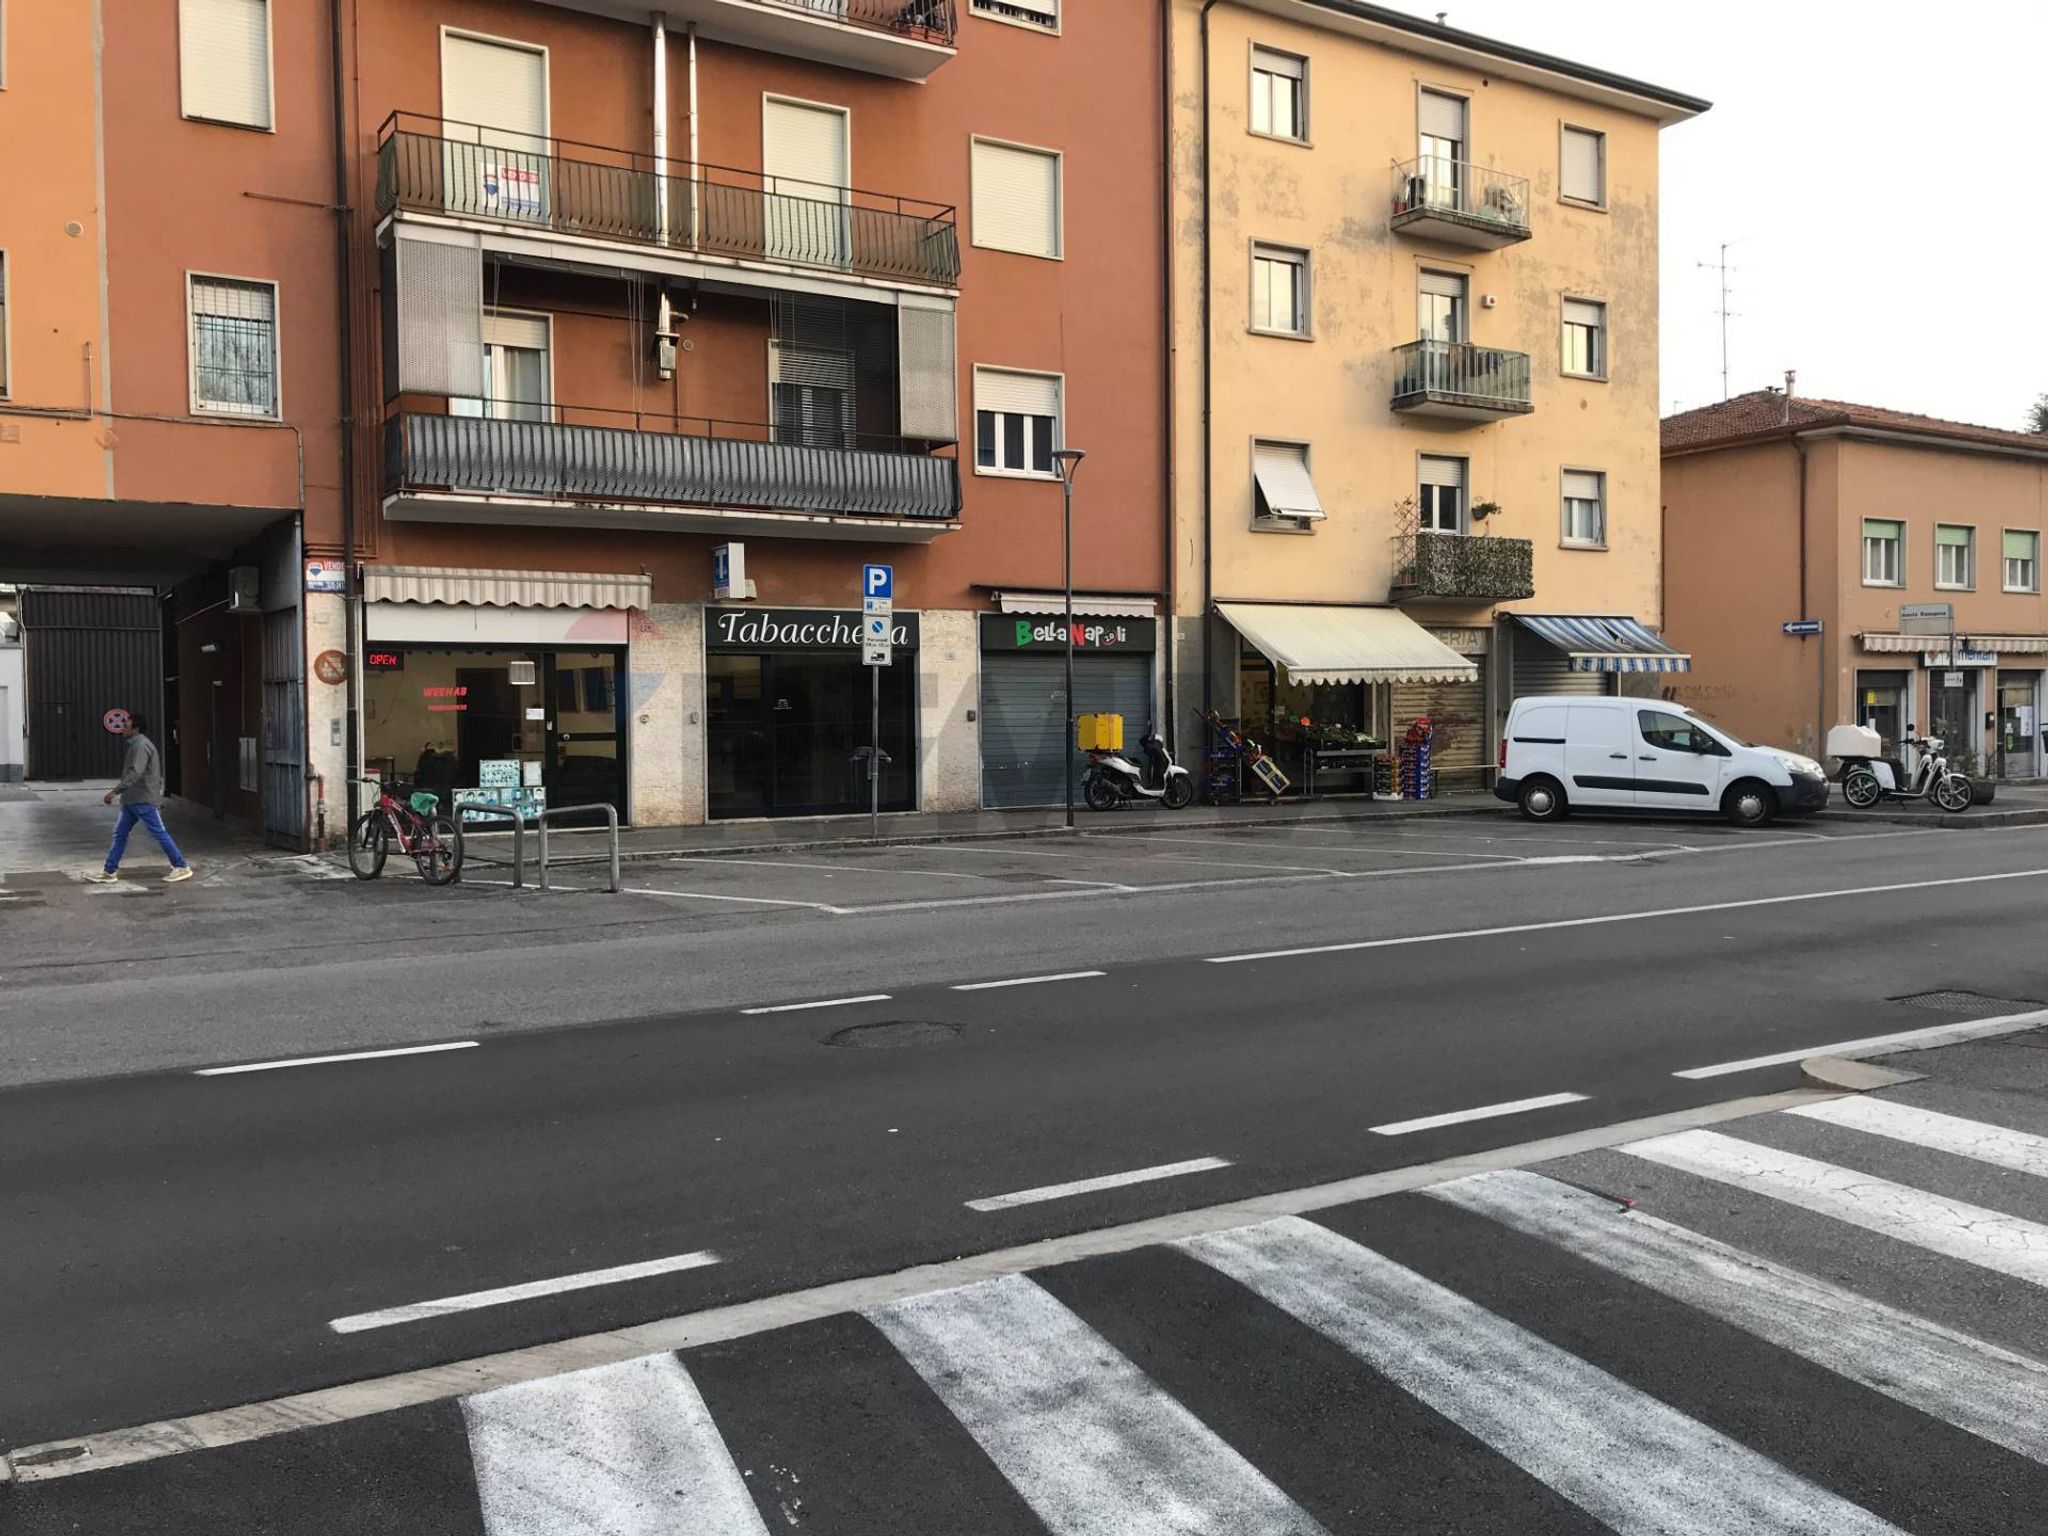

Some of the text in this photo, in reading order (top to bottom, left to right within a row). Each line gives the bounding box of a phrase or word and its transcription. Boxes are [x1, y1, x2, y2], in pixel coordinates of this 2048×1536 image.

[715, 548, 728, 580] T
[869, 568, 887, 595] P
[718, 611, 908, 645] Tabacchea
[1434, 631, 1478, 646] ERIA
[369, 653, 397, 665] OPEN
